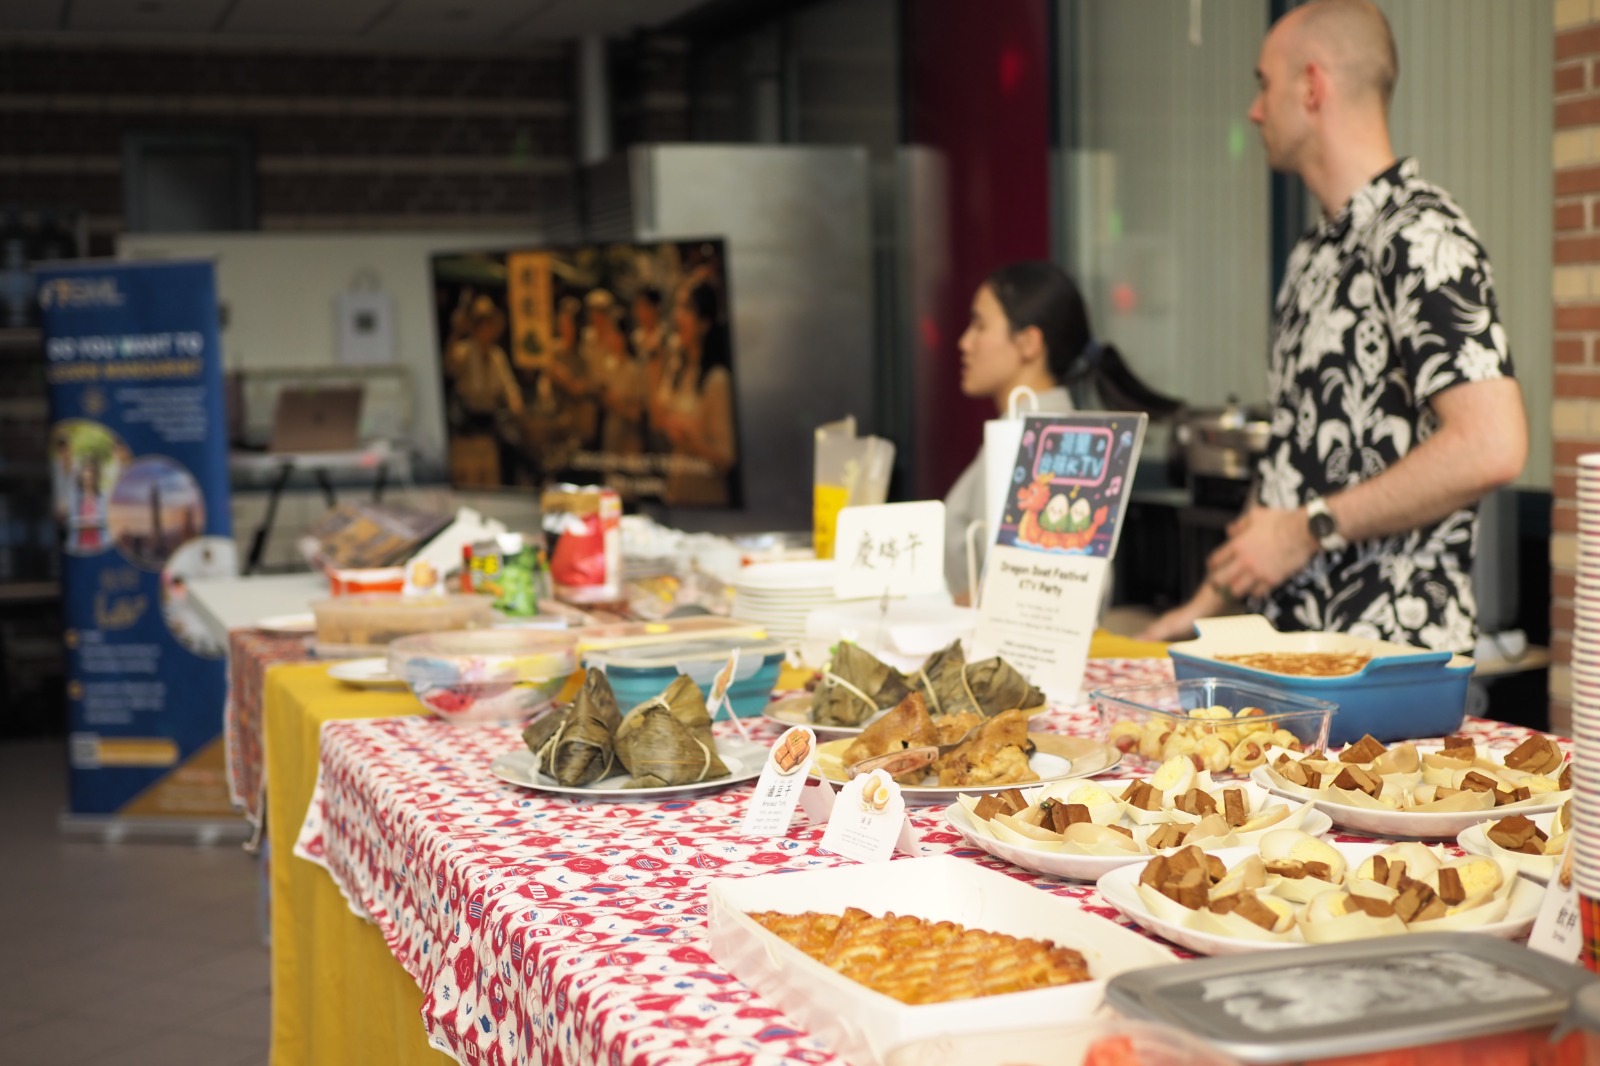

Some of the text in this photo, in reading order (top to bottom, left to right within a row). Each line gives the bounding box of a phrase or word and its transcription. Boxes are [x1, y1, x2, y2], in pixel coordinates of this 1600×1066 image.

[174, 331, 204, 356] TO
[999, 561, 1088, 583] Dragon Boat Festival
[1039, 581, 1062, 598] Party
